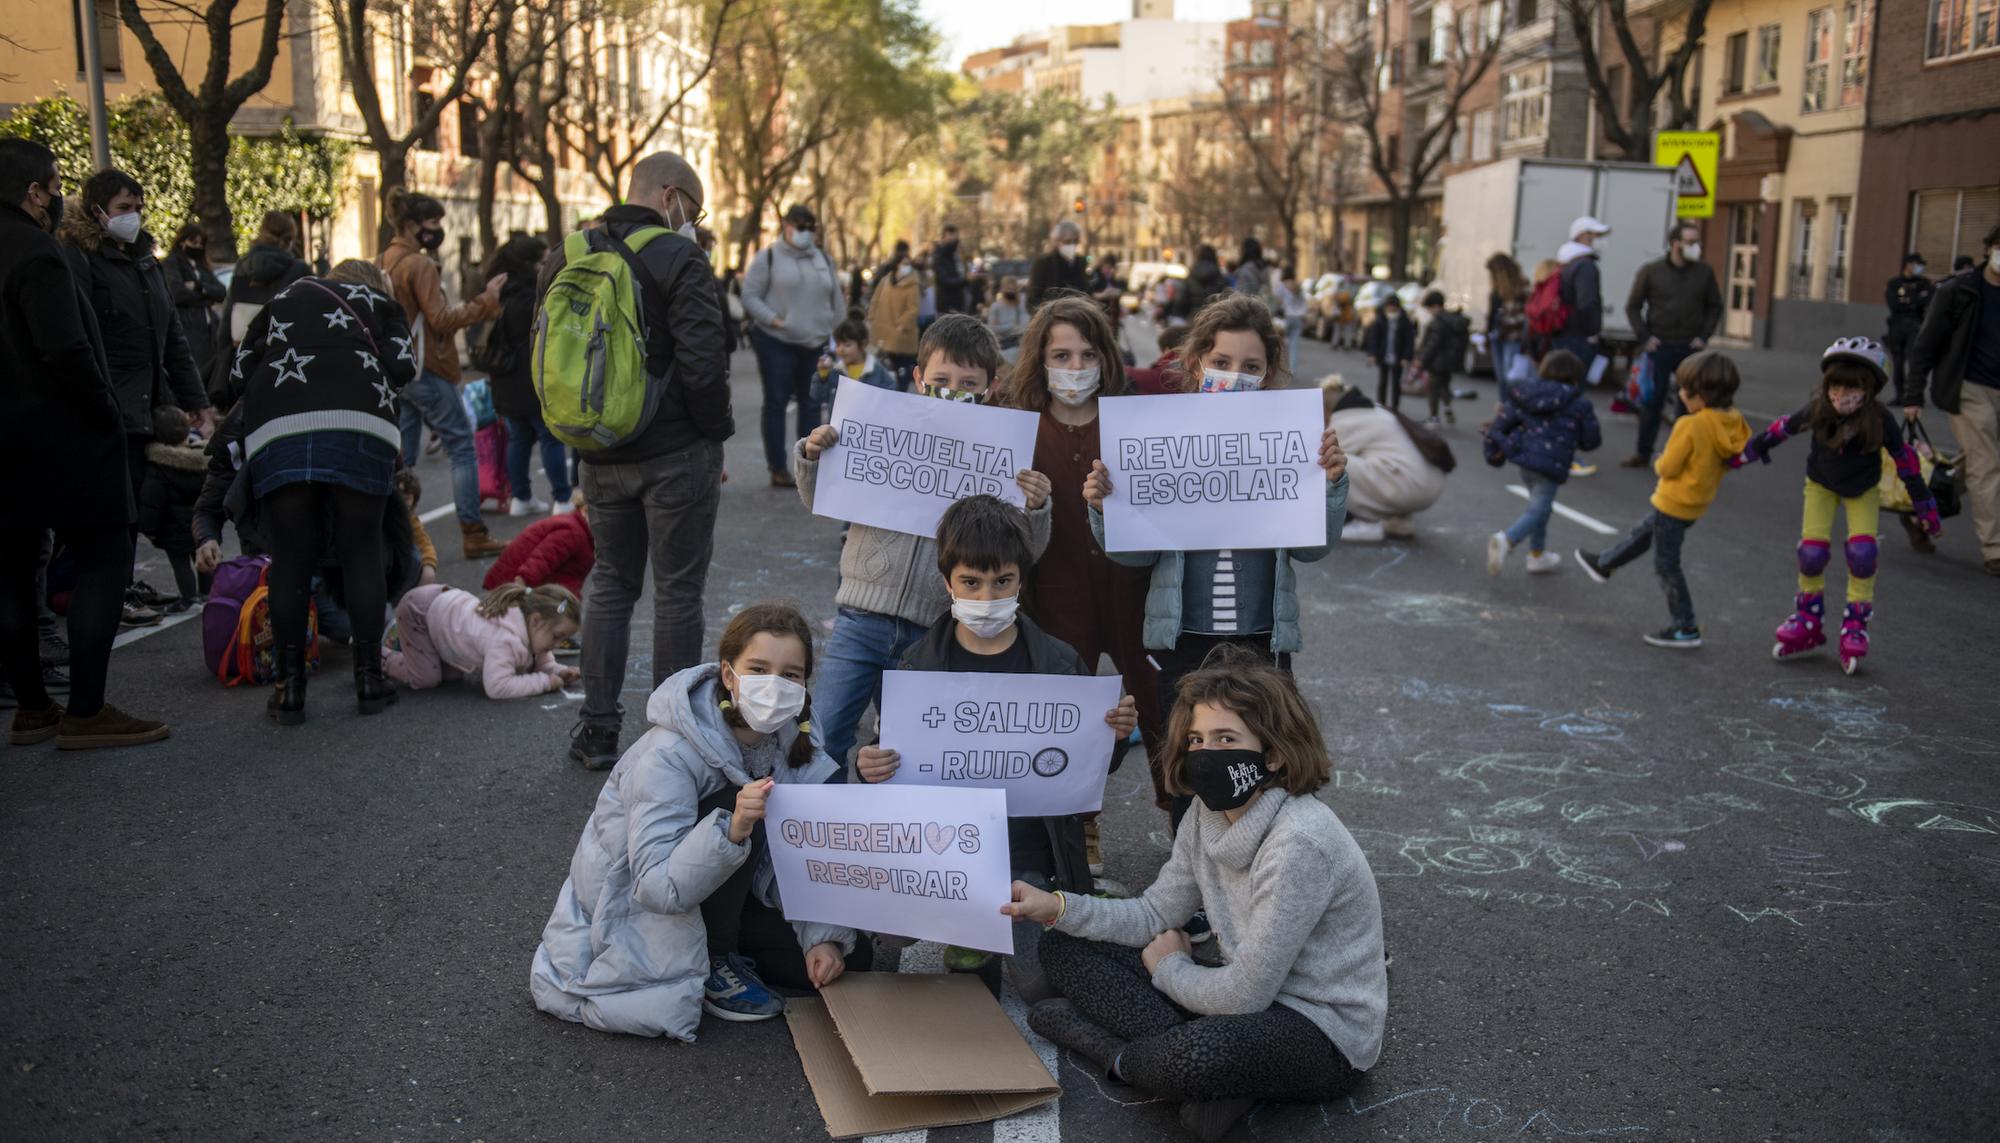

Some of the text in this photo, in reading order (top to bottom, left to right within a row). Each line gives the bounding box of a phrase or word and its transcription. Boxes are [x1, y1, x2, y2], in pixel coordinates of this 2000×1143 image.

[840, 419, 1014, 479] REVUELTA
[1119, 431, 1309, 471] REVUELTA
[1130, 468, 1299, 505] ESCOLAR
[953, 701, 1081, 734] SALUD
[1227, 763, 1258, 780] BEATLES
[781, 819, 981, 855] QUEREMS
[806, 859, 968, 900] RESPIRAR
